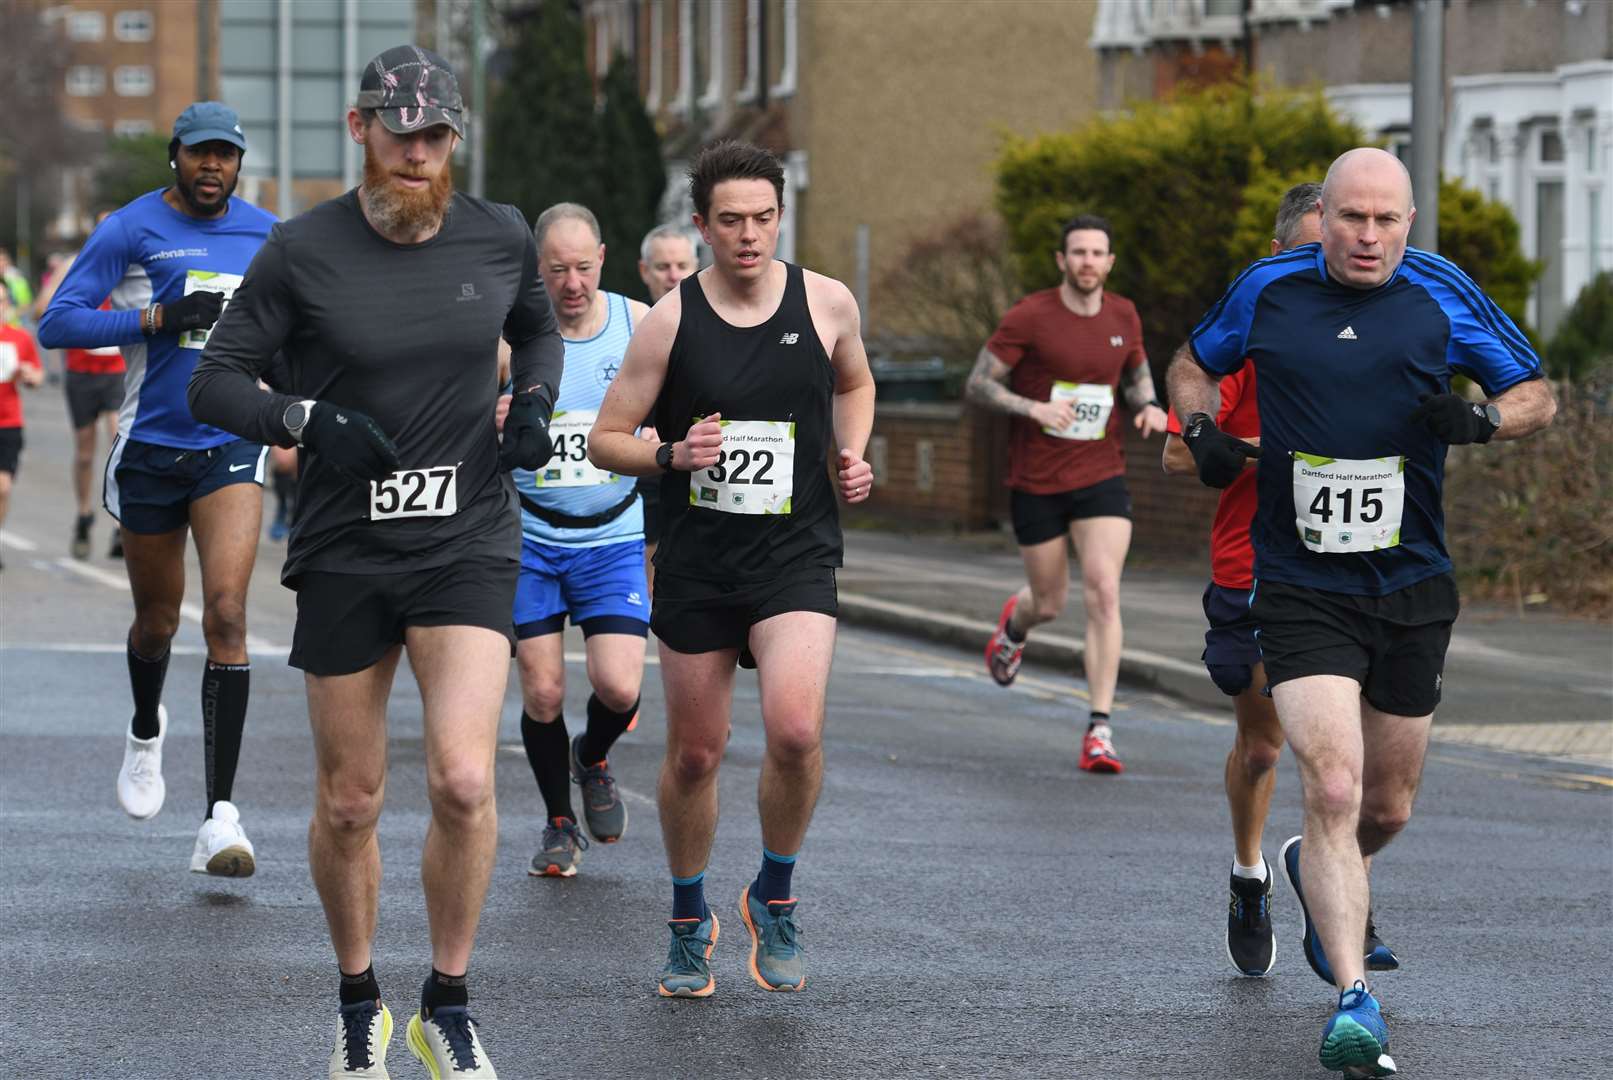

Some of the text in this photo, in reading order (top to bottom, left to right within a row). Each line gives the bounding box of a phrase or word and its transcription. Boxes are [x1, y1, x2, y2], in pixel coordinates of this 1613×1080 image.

[1070, 403, 1101, 423] 69
[552, 433, 587, 462] 43
[746, 435, 784, 443] Marathon
[708, 449, 774, 485] 322
[1302, 469, 1334, 480] Dartford
[1354, 472, 1393, 481] Marathon
[375, 469, 454, 514] 527
[1309, 486, 1383, 524] 415
